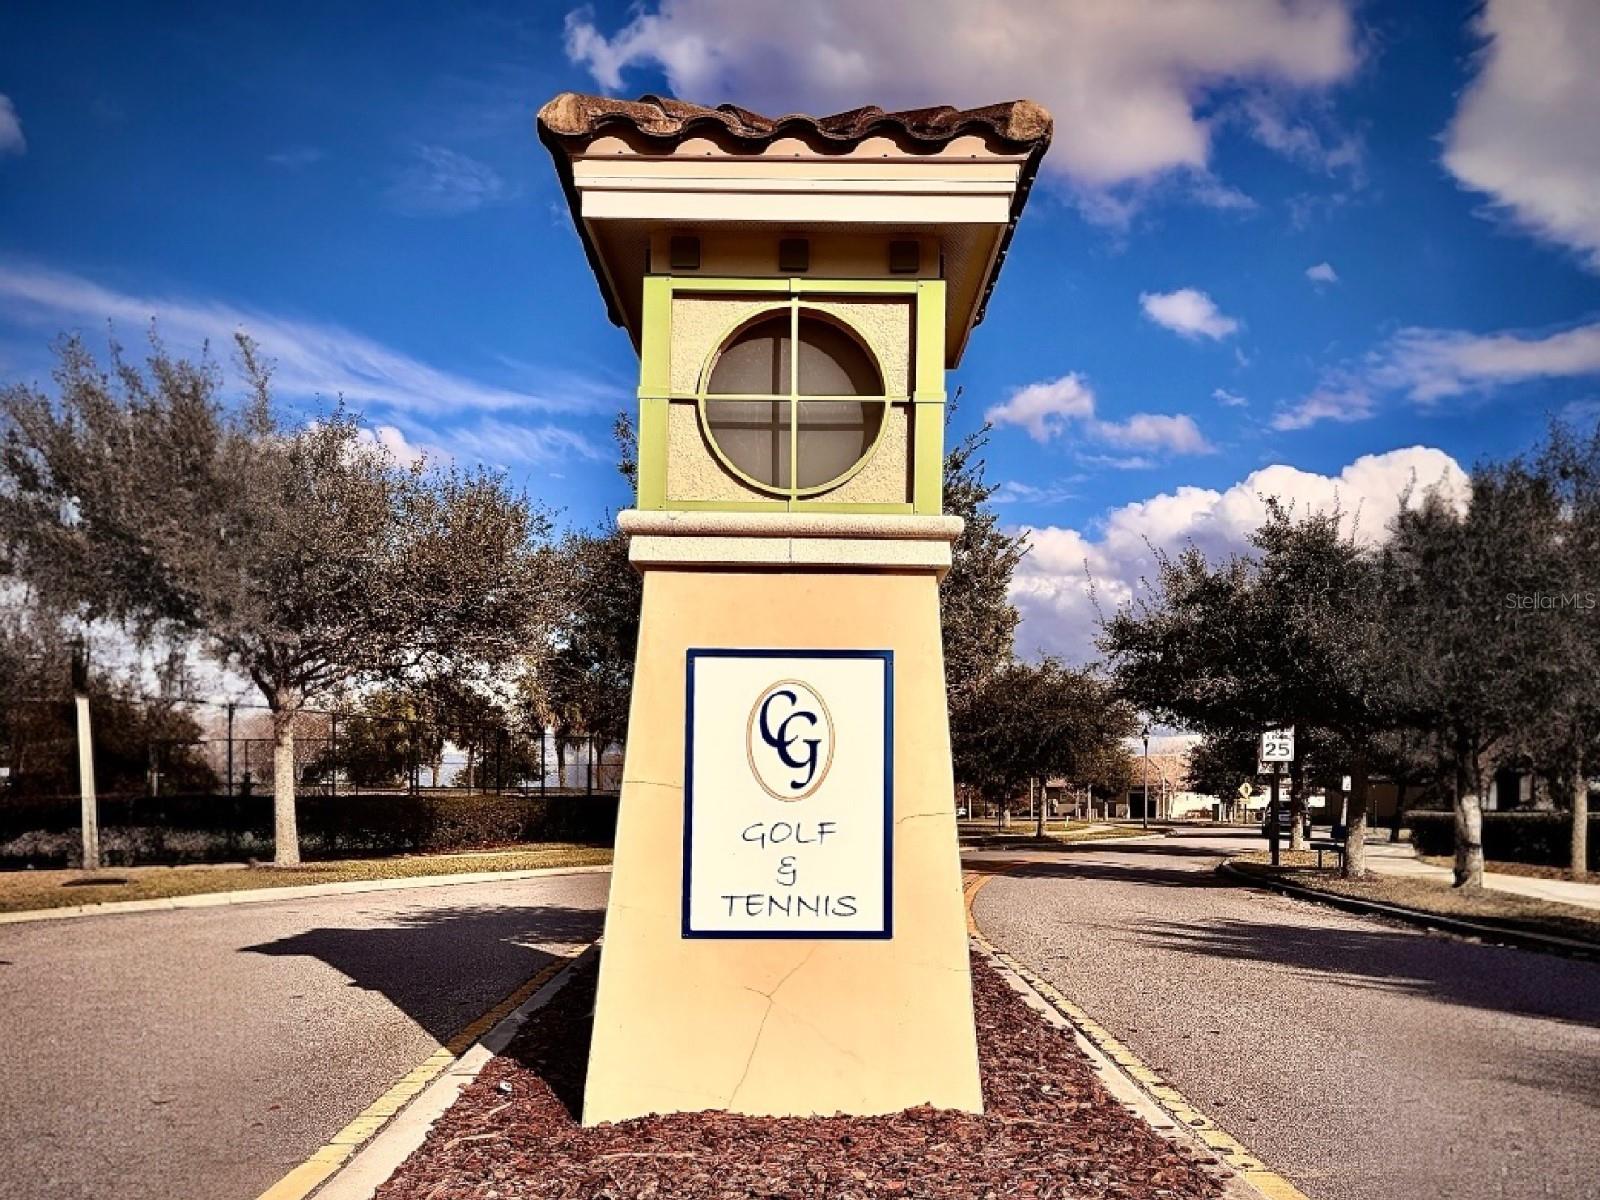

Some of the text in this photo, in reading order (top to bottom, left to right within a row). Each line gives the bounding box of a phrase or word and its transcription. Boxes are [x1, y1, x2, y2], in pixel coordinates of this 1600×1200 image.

[1265, 743, 1290, 757] 25
[742, 821, 838, 849] GOLF
[776, 855, 797, 886] &
[720, 894, 858, 917] TENNIS
